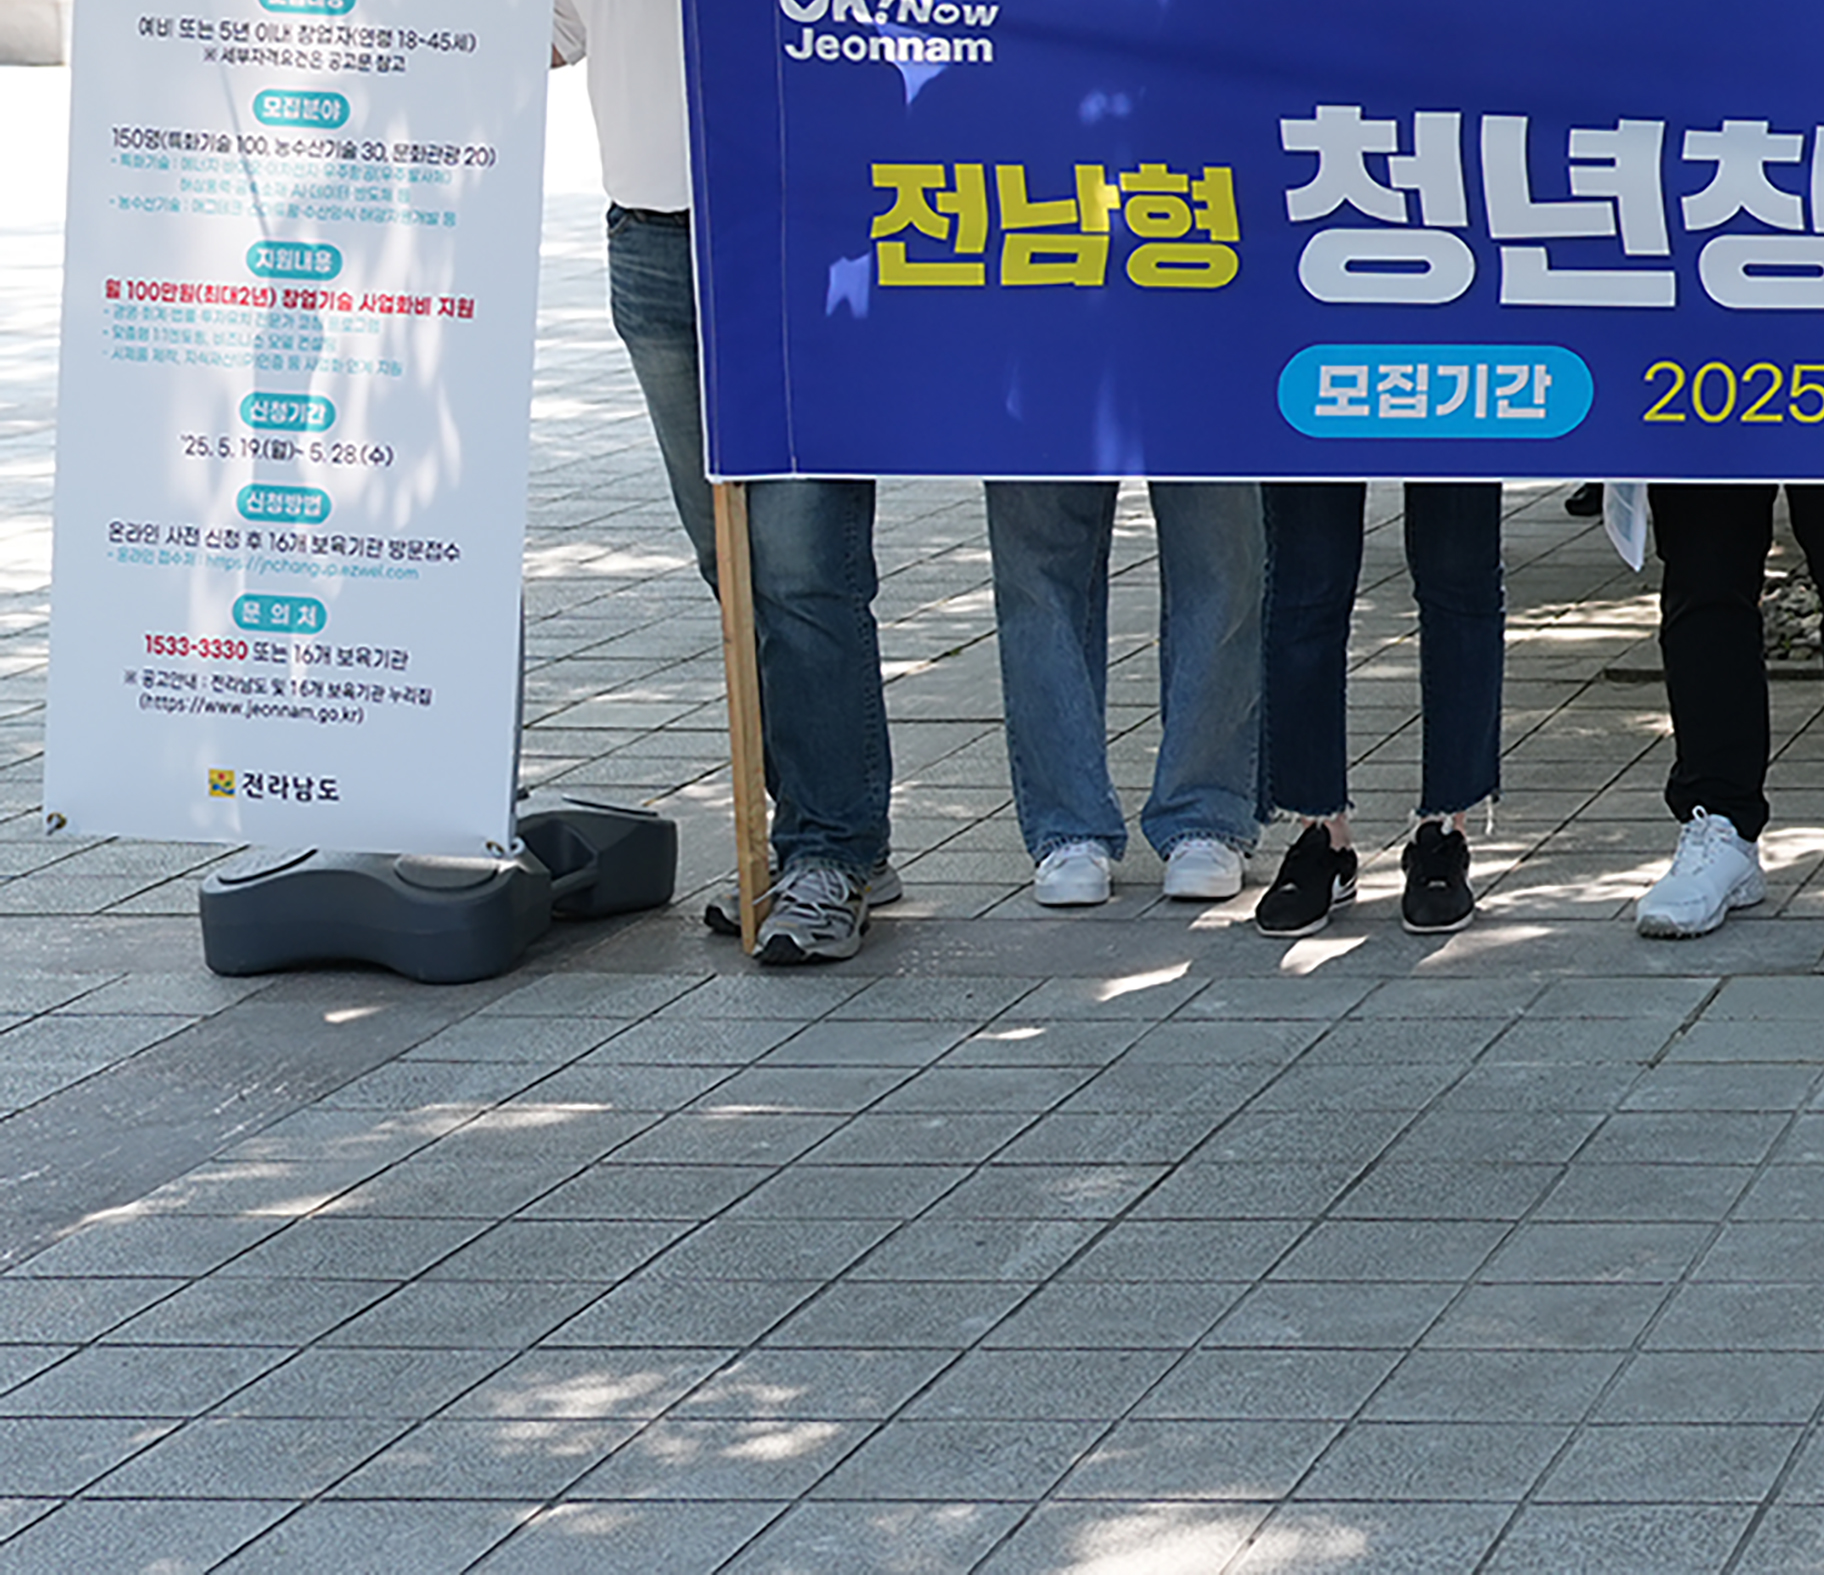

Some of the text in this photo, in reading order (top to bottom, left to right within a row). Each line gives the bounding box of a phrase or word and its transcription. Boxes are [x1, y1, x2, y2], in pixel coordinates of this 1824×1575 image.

[785, 28, 992, 63] Jeonnam
[870, 164, 1239, 288] 전남형
[1315, 364, 1552, 418] 모집기간
[249, 401, 326, 426] 신청기간
[110, 522, 459, 561] 온라인 사전 신청 후 16개 보육기관 방문접수
[146, 635, 408, 671] 1533-3330 또는 16개 보육기관
[243, 773, 339, 802] 전라남도
